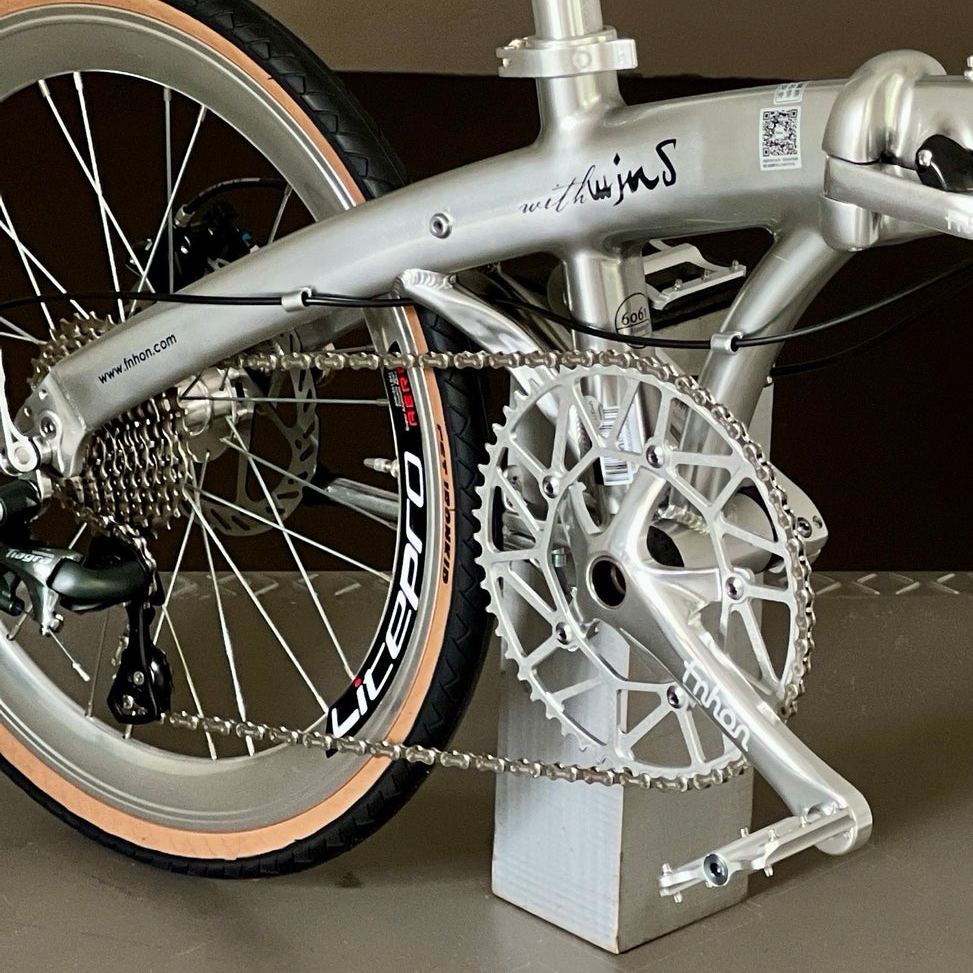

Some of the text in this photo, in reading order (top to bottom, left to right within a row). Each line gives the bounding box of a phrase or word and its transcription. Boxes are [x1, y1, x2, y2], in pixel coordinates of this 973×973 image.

[98, 334, 177, 384] www.fnhon.com
[5, 548, 53, 565] Tiagra
[682, 660, 750, 753] fnhon
